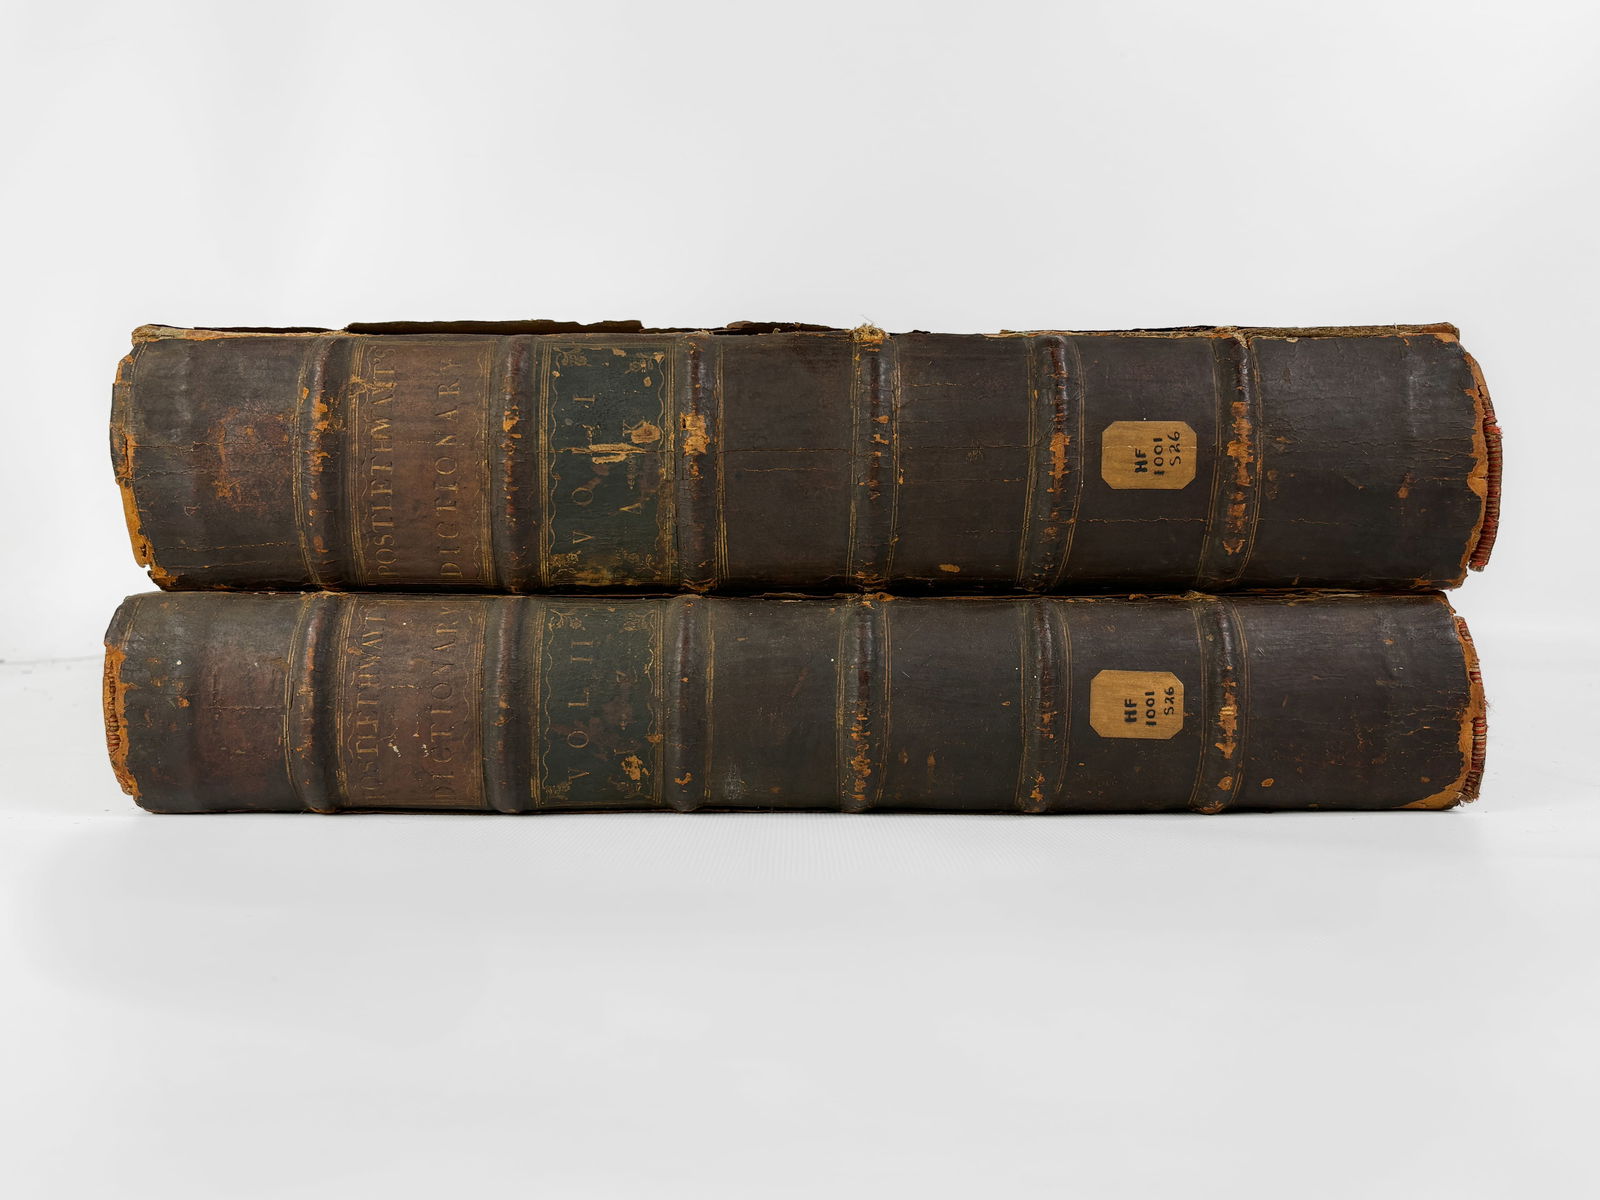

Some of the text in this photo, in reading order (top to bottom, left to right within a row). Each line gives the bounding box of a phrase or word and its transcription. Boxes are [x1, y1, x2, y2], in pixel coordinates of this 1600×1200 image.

[1134, 447, 1148, 472] HF
[1153, 437, 1165, 475] 1001
[1166, 431, 1182, 466] S26
[434, 357, 464, 578] DICTIONARY
[430, 606, 458, 799] DICTIONARY
[1124, 698, 1137, 722] HF
[1145, 691, 1157, 726] 1001
[1163, 686, 1175, 716] S26
[567, 687, 593, 779] VOL
